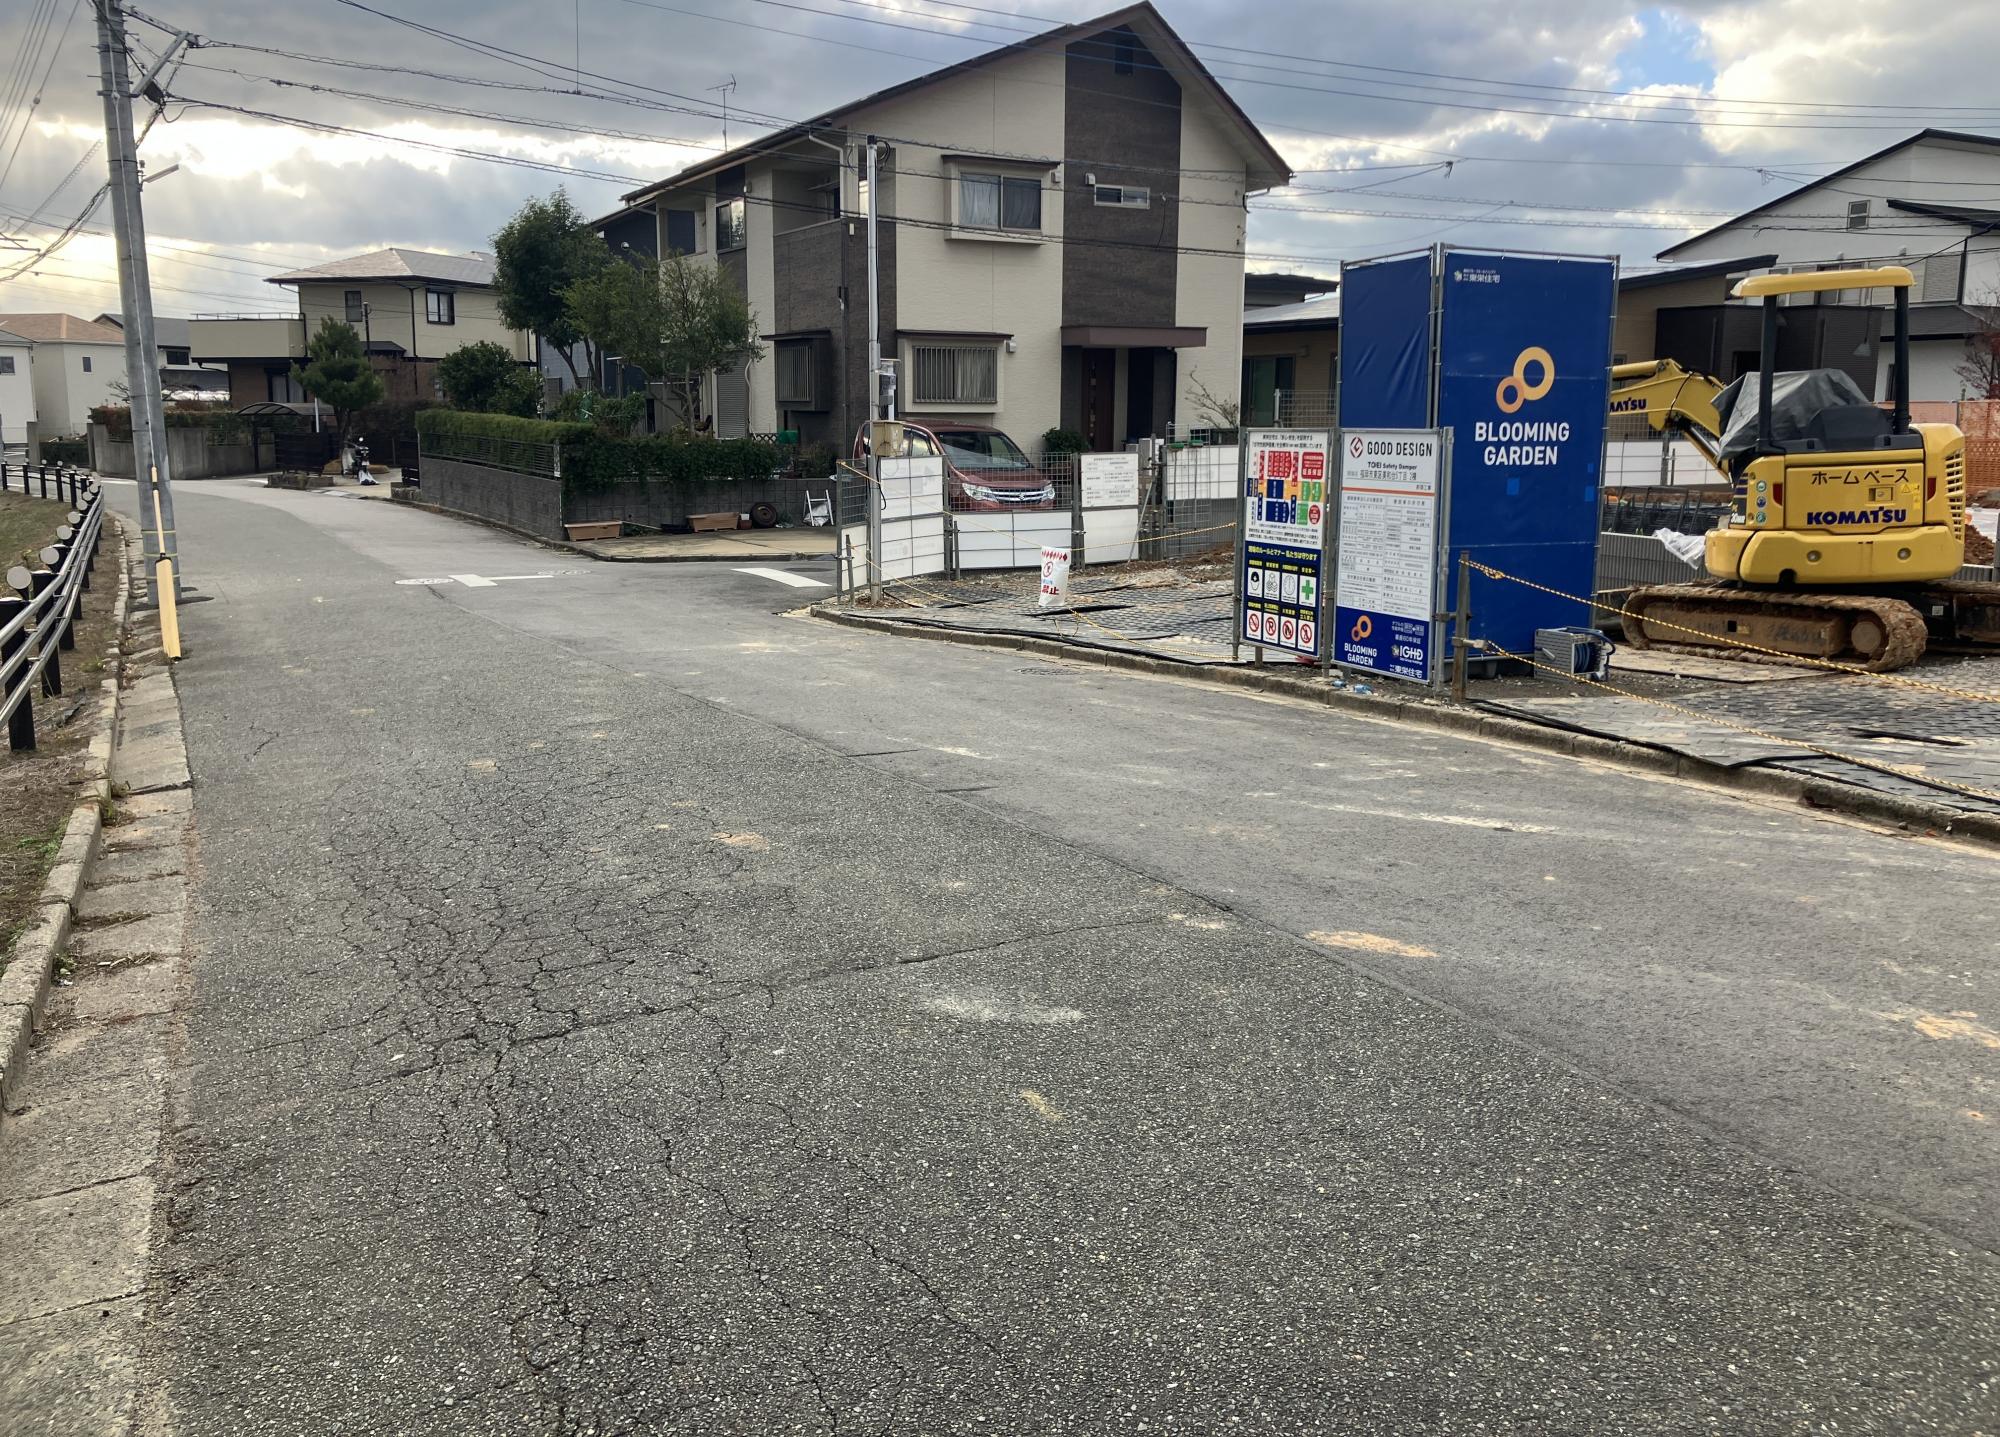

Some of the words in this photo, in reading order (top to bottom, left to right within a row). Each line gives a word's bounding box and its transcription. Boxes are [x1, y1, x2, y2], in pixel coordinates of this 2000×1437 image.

[1475, 422, 1570, 442] BLOOMING
[1367, 441, 1393, 456] GOOD
[1396, 443, 1433, 457] DESIGN
[1484, 446, 1558, 466] GARDEN
[1812, 471, 1859, 485] ホーム
[1864, 469, 1909, 483] ベース
[1807, 507, 1906, 525] KOMATSU
[1344, 643, 1377, 657] BLOOMING
[1347, 653, 1373, 667] GARDEN
